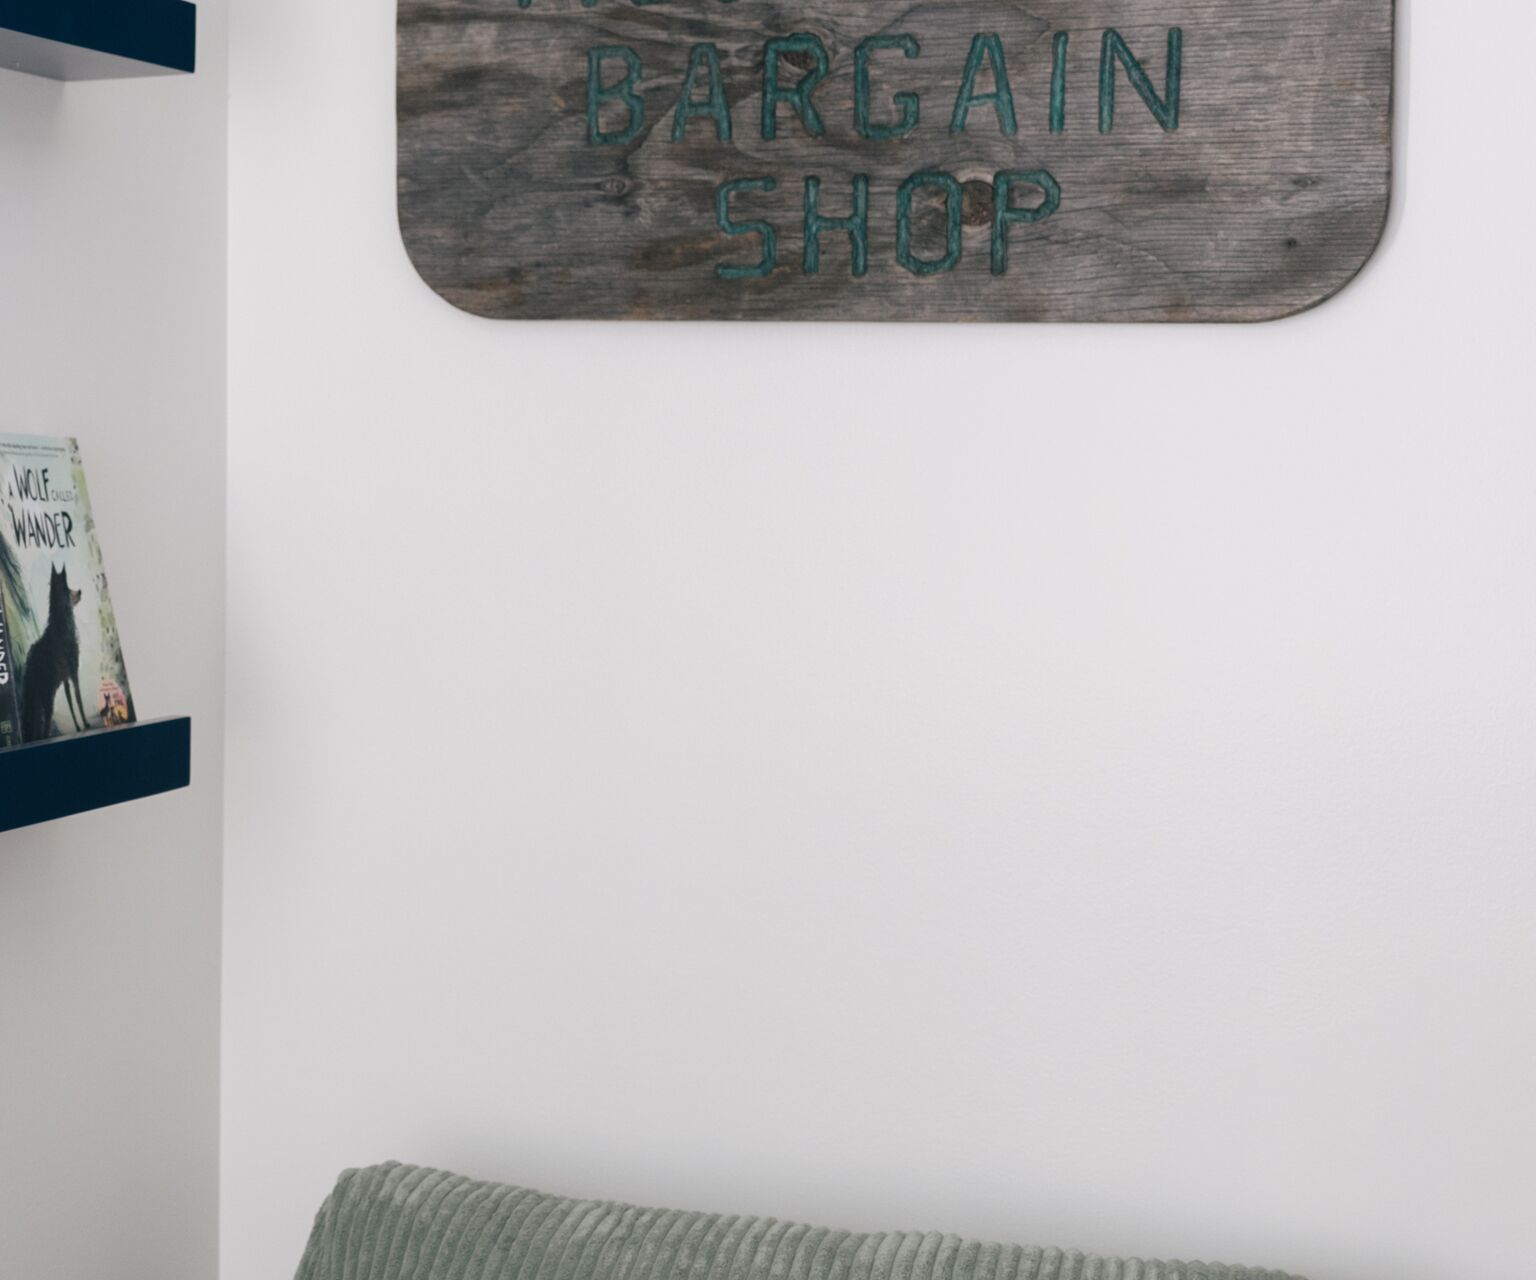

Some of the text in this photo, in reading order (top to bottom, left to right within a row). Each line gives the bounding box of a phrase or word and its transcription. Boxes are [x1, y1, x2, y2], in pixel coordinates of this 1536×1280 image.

[586, 25, 1184, 147] BARGAIN
[715, 167, 1060, 278] SHOP
[13, 464, 50, 502] WOLF
[8, 503, 76, 548] WANDER
